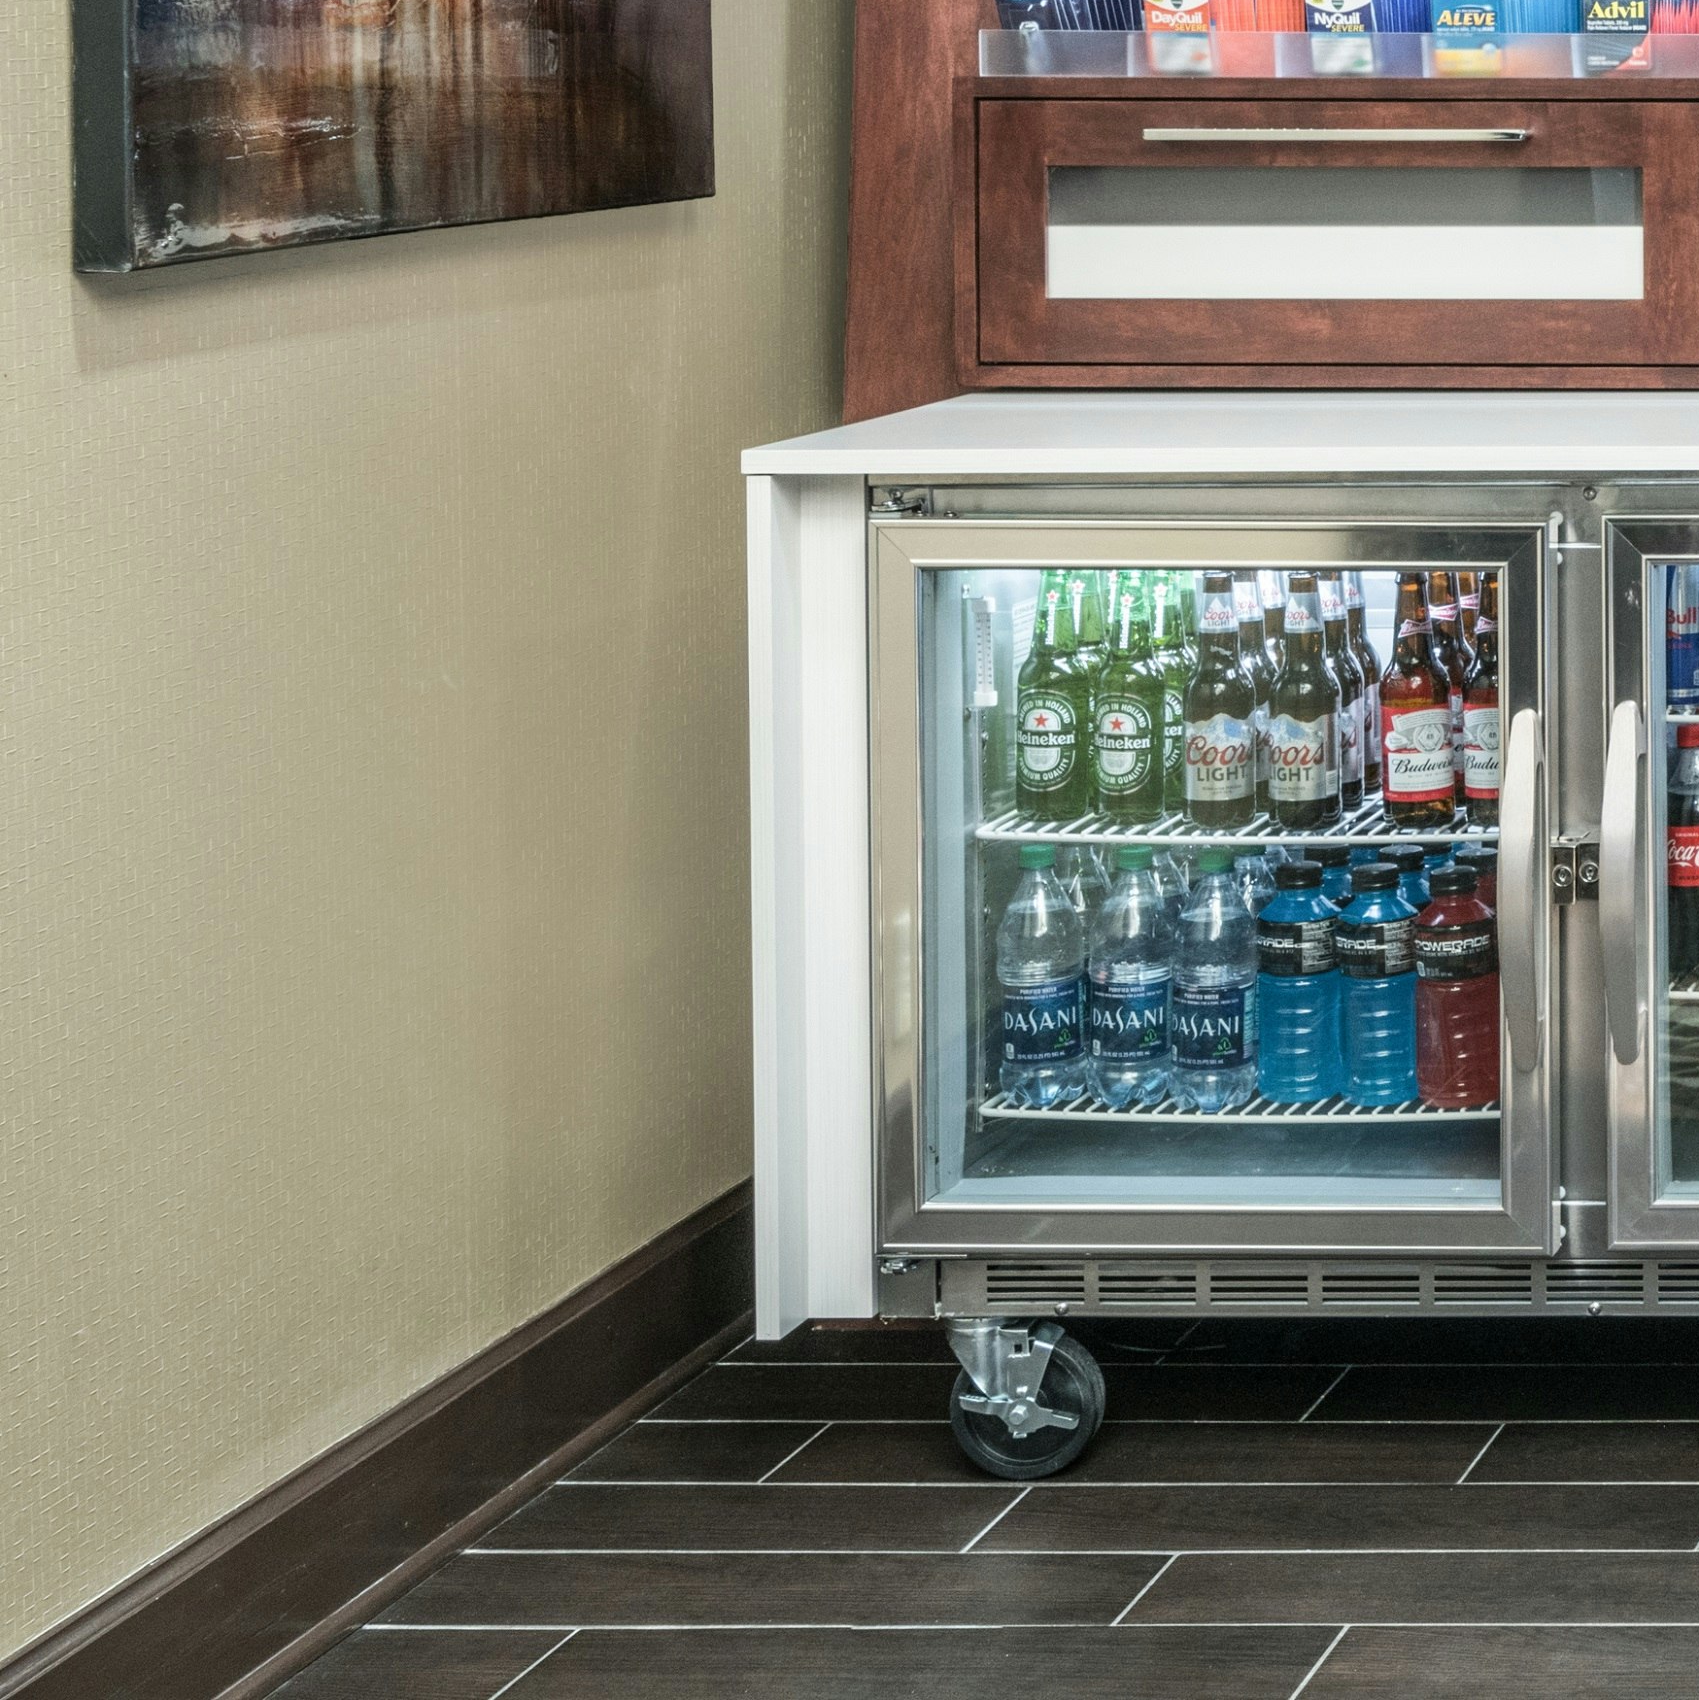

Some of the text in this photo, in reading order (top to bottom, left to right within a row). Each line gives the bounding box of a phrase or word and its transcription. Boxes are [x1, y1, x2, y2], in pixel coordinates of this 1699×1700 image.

[1151, 11, 1203, 25] DayQuil
[1314, 11, 1360, 27] NyQuil
[1437, 9, 1496, 26] ALEVE
[1587, 0, 1645, 19] Advil
[1174, 23, 1207, 32] SEVERE
[1331, 24, 1365, 32] SEVERE
[1203, 608, 1235, 621] Coors
[1045, 700, 1071, 725] HOLLAND
[1121, 703, 1147, 729] HOLLAND
[1042, 757, 1070, 781] QUALITY
[1118, 761, 1145, 784] QUALITY
[1196, 765, 1248, 782] LIGHT
[1004, 1006, 1077, 1034] DASANI
[1092, 1006, 1164, 1033] DASANI
[1172, 1012, 1240, 1040] DASANI
